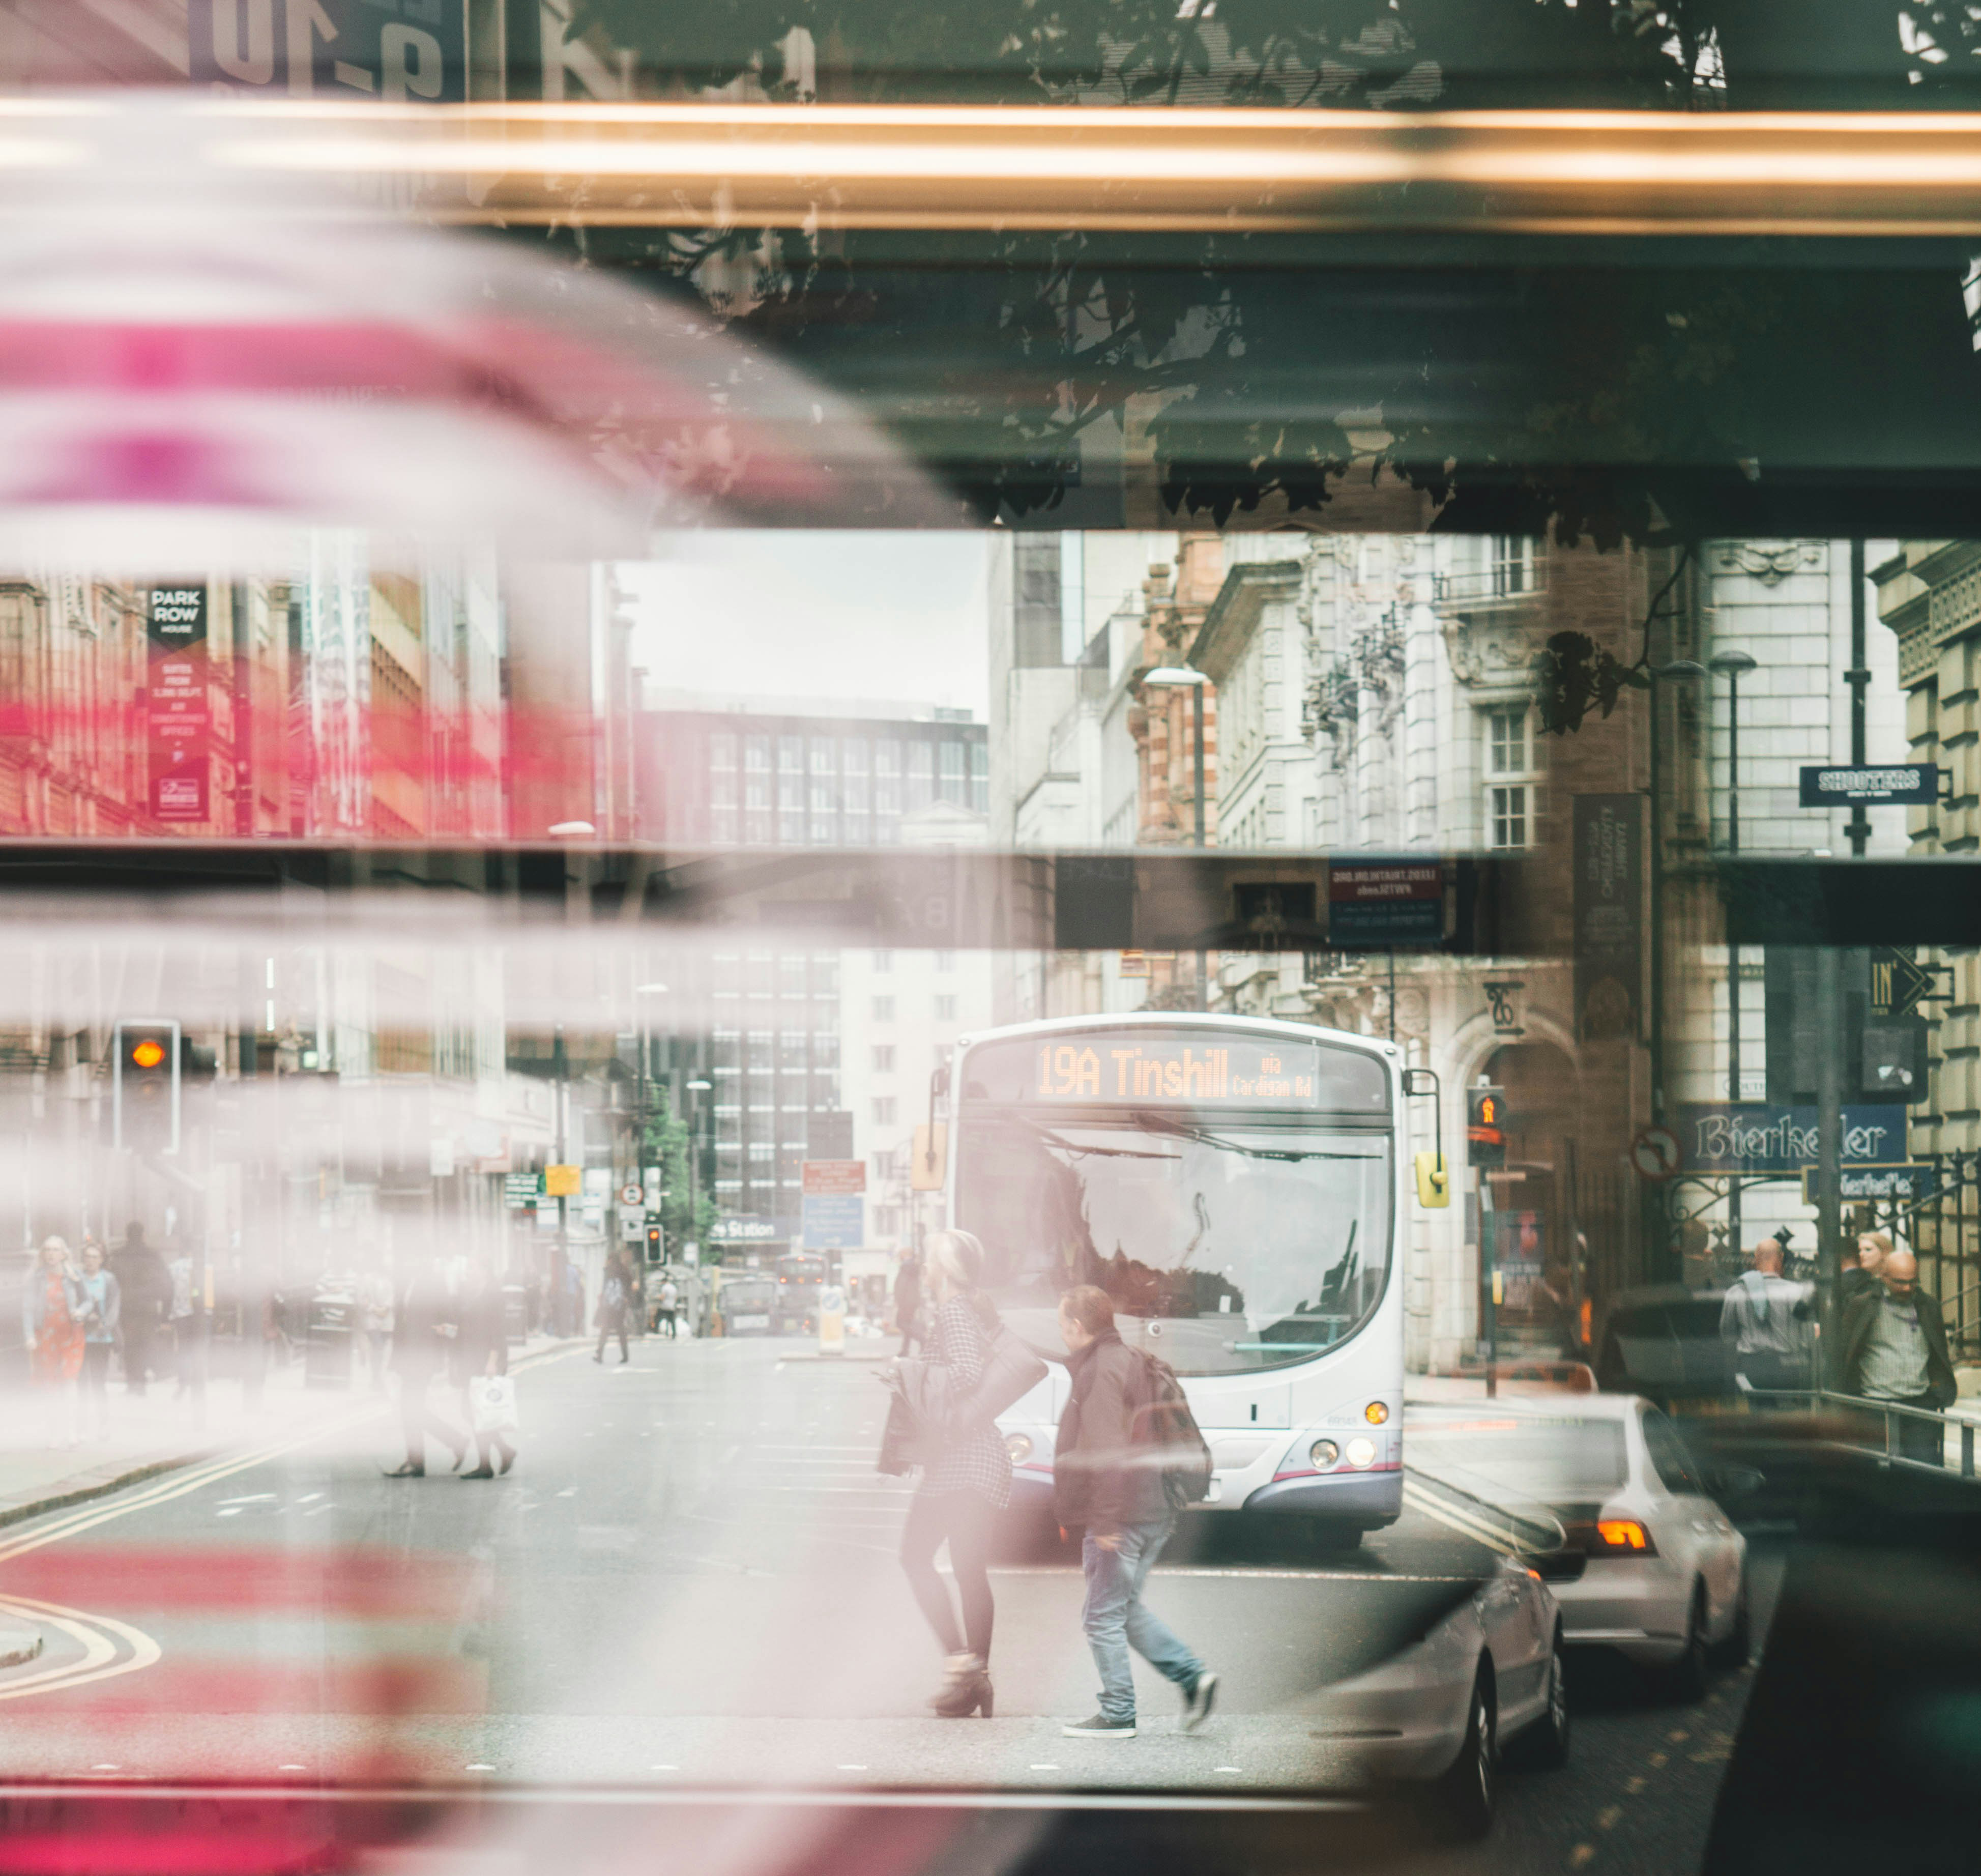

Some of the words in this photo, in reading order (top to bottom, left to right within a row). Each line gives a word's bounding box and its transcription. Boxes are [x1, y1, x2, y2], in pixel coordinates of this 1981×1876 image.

[151, 590, 201, 605] PARK
[154, 607, 199, 622] ROW
[1818, 769, 1920, 791] SHOOTERS
[1038, 1046, 1100, 1095] 19A
[1111, 1048, 1228, 1098] Tinshill
[1261, 1054, 1281, 1074] via
[1233, 1075, 1290, 1097] Cardigan
[1295, 1076, 1312, 1098] Rd
[1695, 1113, 1888, 1160] Bierkeler
